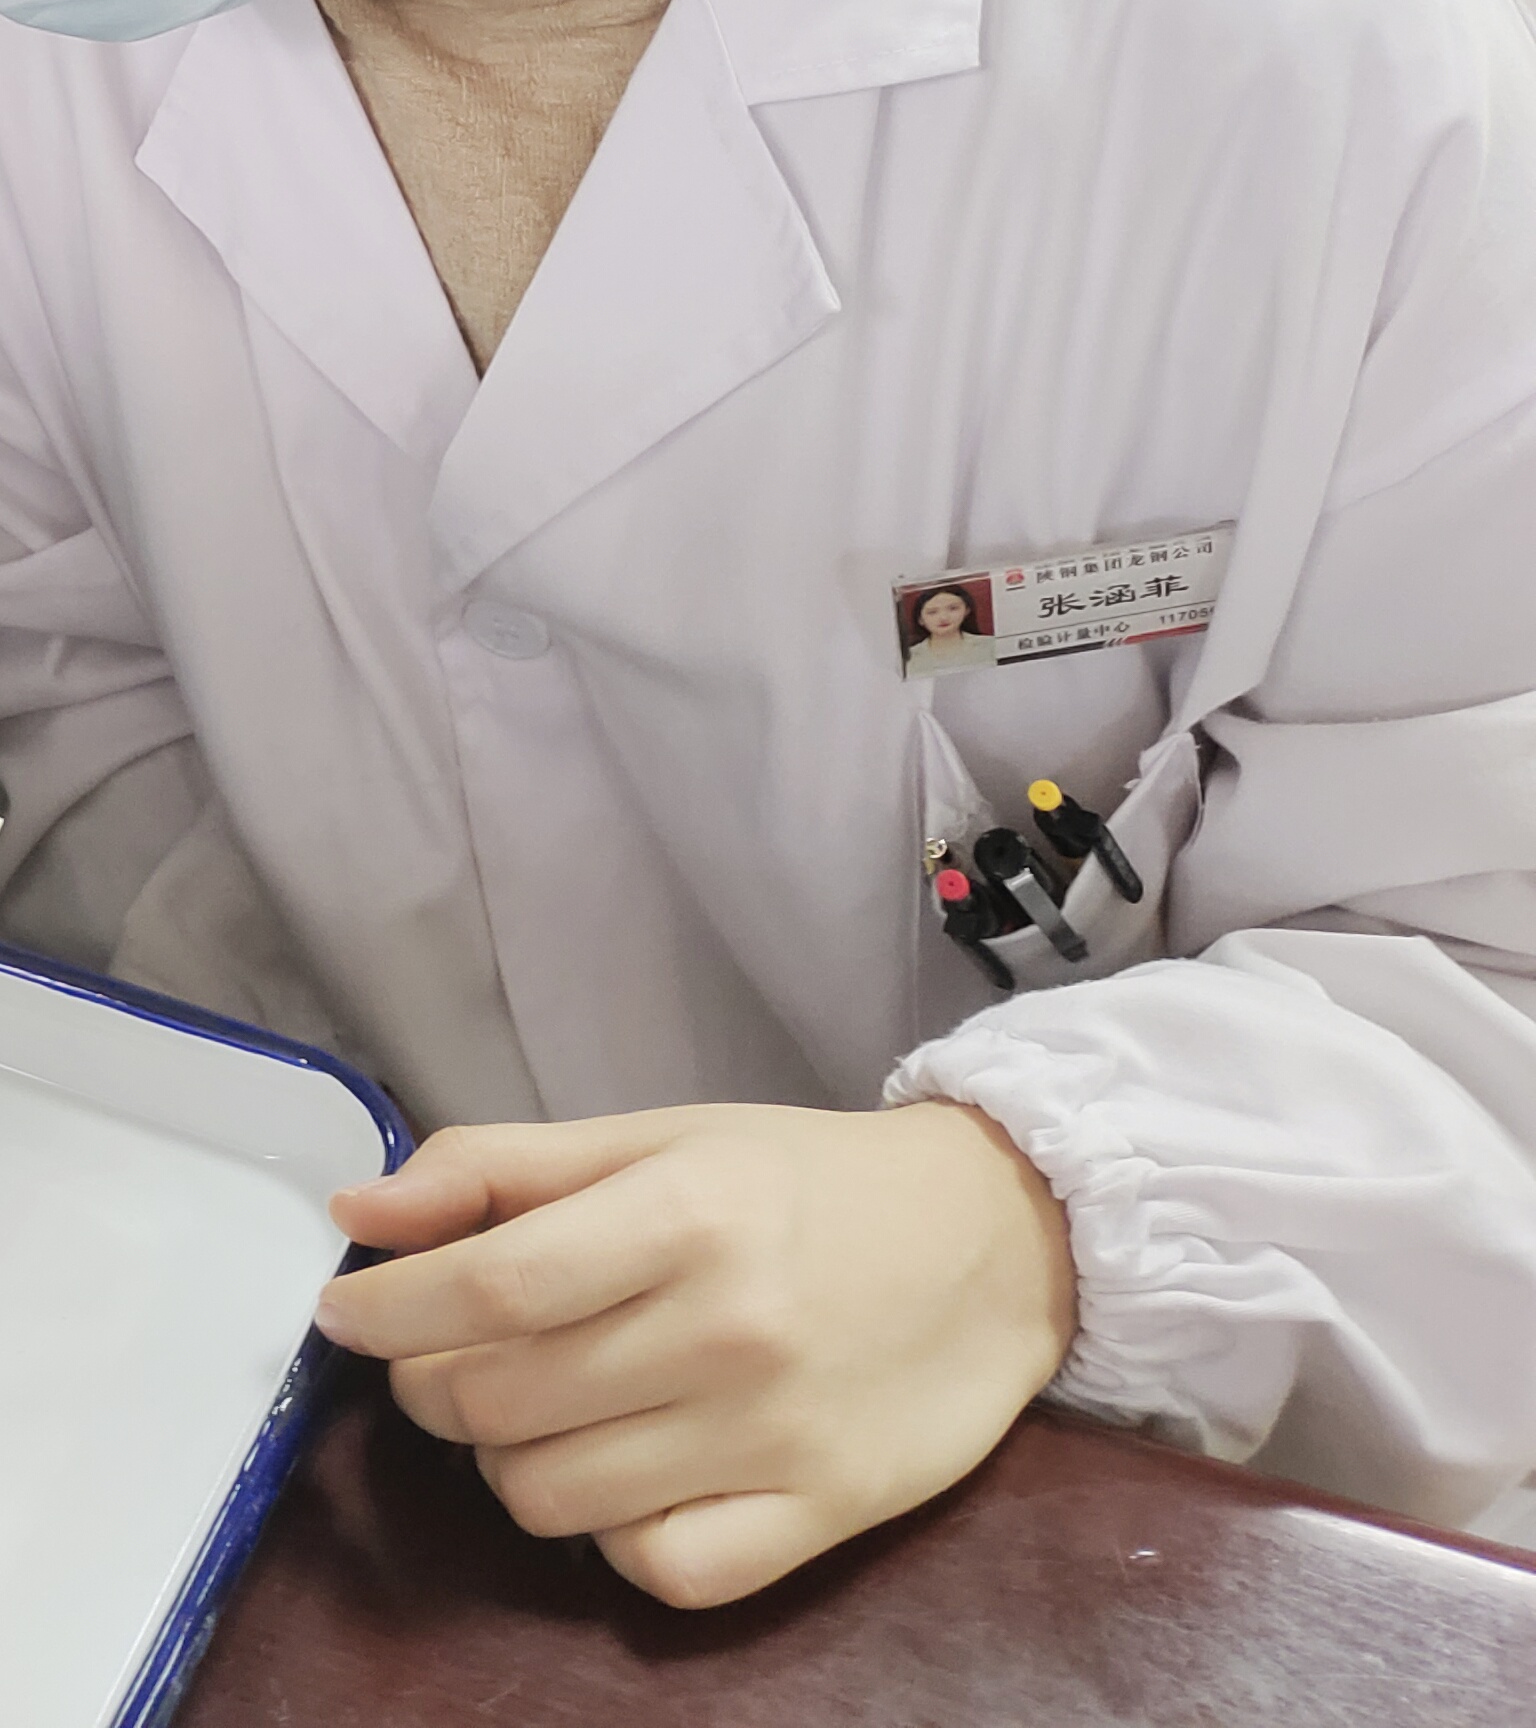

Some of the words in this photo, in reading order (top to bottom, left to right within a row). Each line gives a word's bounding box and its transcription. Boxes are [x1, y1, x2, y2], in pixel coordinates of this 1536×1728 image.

[1035, 539, 1214, 584] 陕钢集团龙钢公司
[1038, 575, 1190, 619] 张涵菲
[1017, 622, 1131, 651] 检验计量中心
